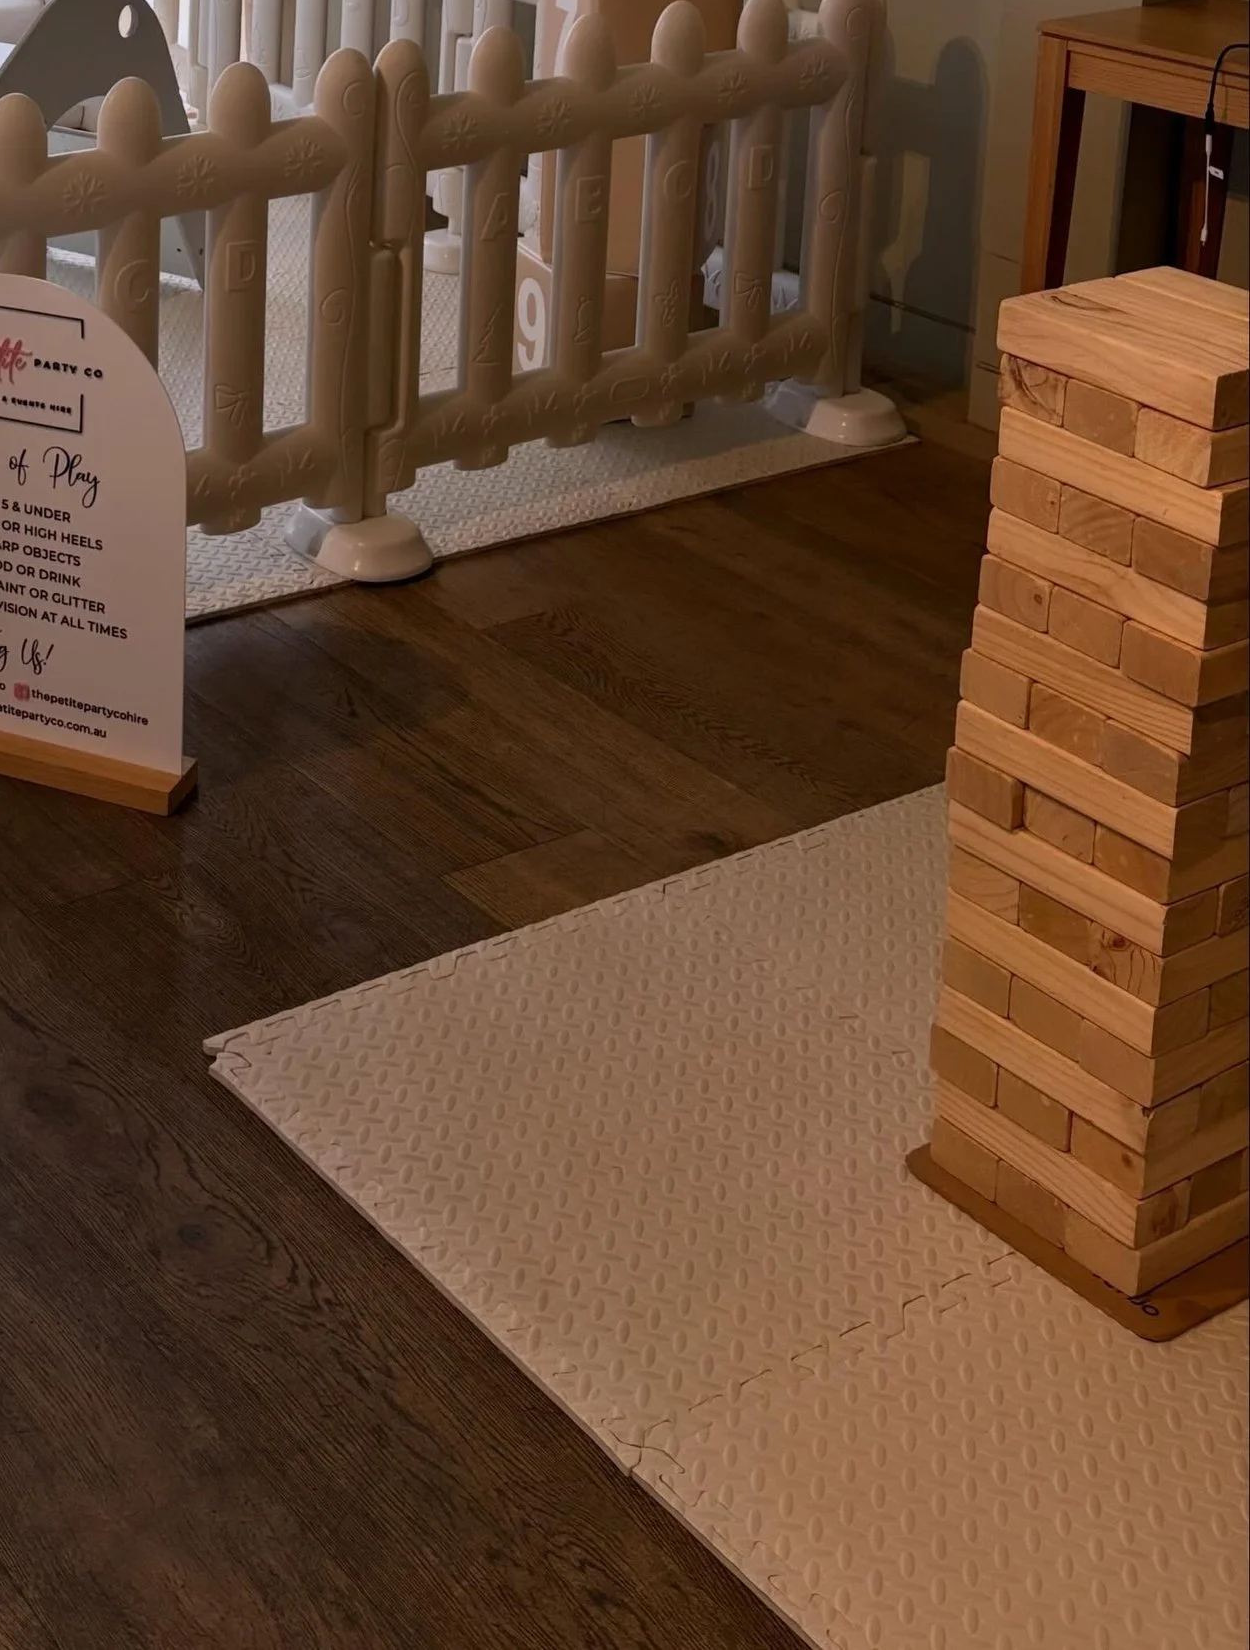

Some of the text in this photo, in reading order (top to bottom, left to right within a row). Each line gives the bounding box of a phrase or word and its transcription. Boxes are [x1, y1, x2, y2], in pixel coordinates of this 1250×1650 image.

[517, 277, 546, 371] 9
[34, 358, 78, 374] PARTY
[84, 368, 103, 379] CO
[11, 397, 46, 410] EVENTS
[9, 449, 29, 486] of
[43, 446, 100, 508] Play
[1, 499, 9, 510] 5
[12, 501, 21, 512] &
[23, 503, 71, 523] UNDER
[1, 520, 20, 533] OR
[24, 524, 57, 541] HIGH
[61, 532, 103, 550] HEELS
[23, 545, 81, 567] OBJECTS
[16, 564, 35, 578] OR
[38, 568, 81, 588] DRINK
[29, 587, 49, 601] OR
[52, 593, 106, 614] GLITTER
[41, 611, 58, 623] AT
[60, 615, 85, 630] ALL
[87, 621, 128, 639] TIMES
[21, 638, 54, 675] Us!
[31, 689, 149, 726] thepetitepartycohire
